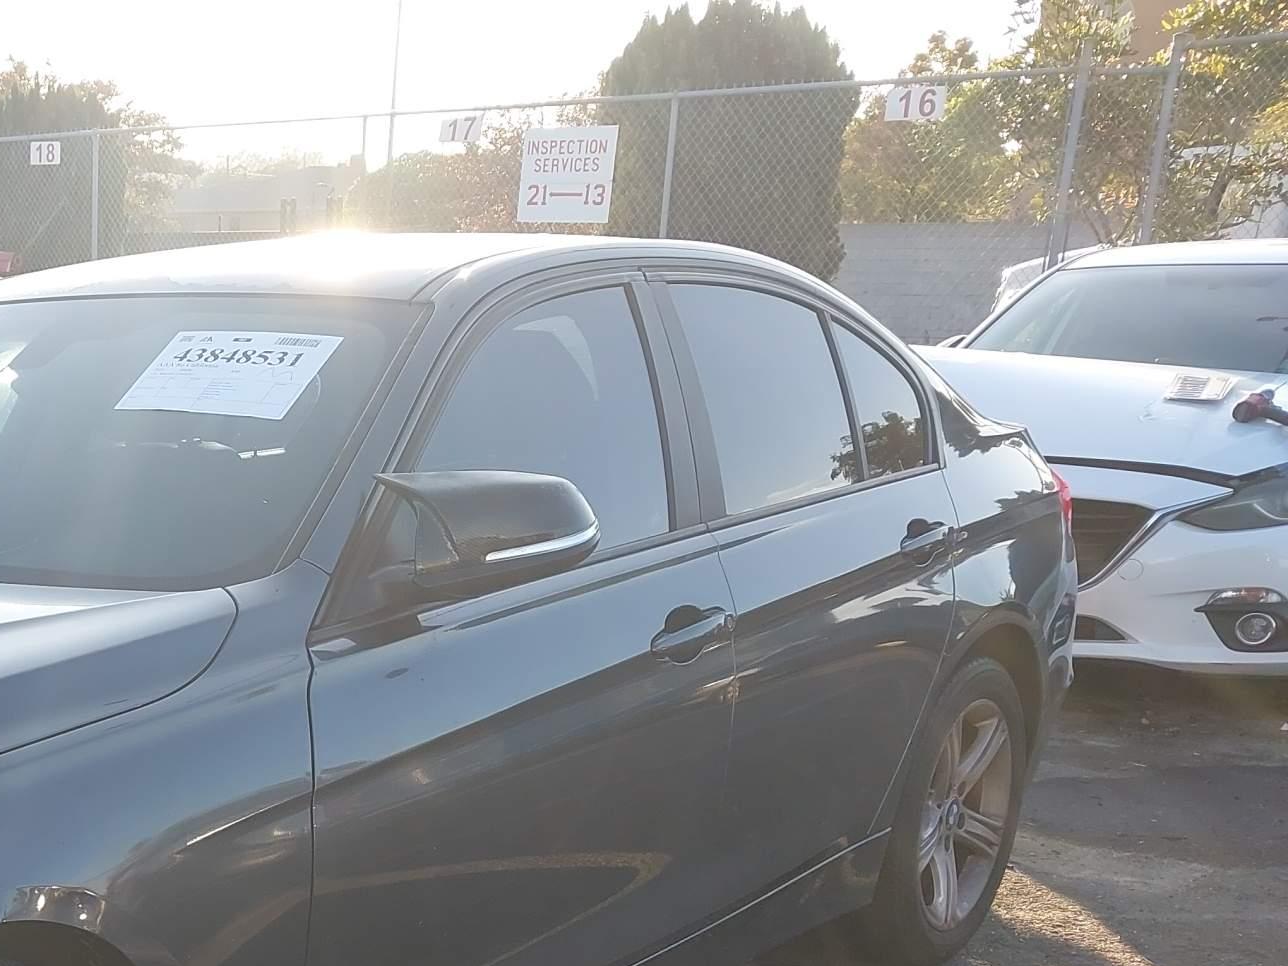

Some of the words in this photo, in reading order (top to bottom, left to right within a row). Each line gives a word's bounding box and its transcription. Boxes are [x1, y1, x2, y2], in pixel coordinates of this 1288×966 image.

[898, 88, 936, 119] 16
[448, 116, 477, 141] 17
[35, 144, 55, 163] 18
[527, 139, 608, 155] INSPECTION
[534, 157, 600, 173] SERVICES
[526, 183, 548, 206] 21
[583, 183, 606, 206] 13
[173, 347, 305, 368] 43848531
